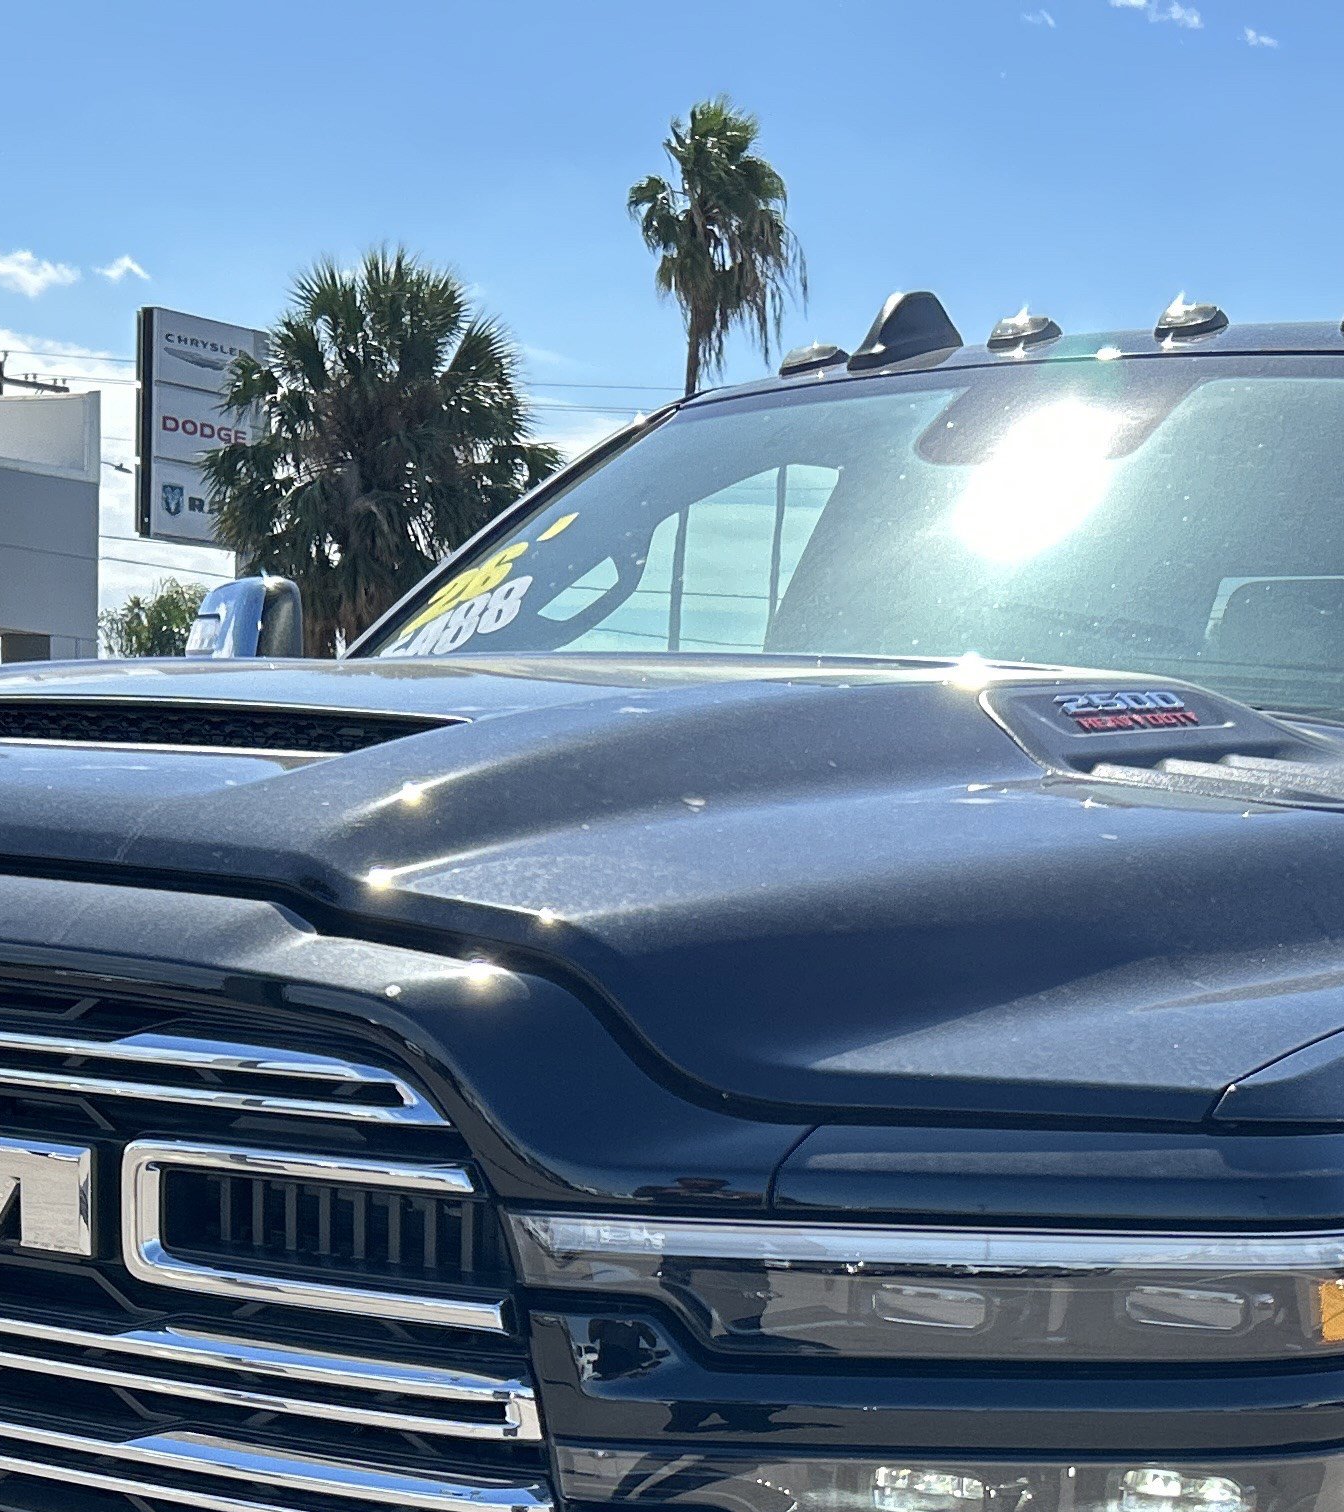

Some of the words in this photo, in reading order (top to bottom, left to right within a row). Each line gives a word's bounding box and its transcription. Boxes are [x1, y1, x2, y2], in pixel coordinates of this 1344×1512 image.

[165, 333, 243, 357] CHRYSLE
[162, 415, 247, 445] DODGE
[1053, 691, 1185, 715] 2500
